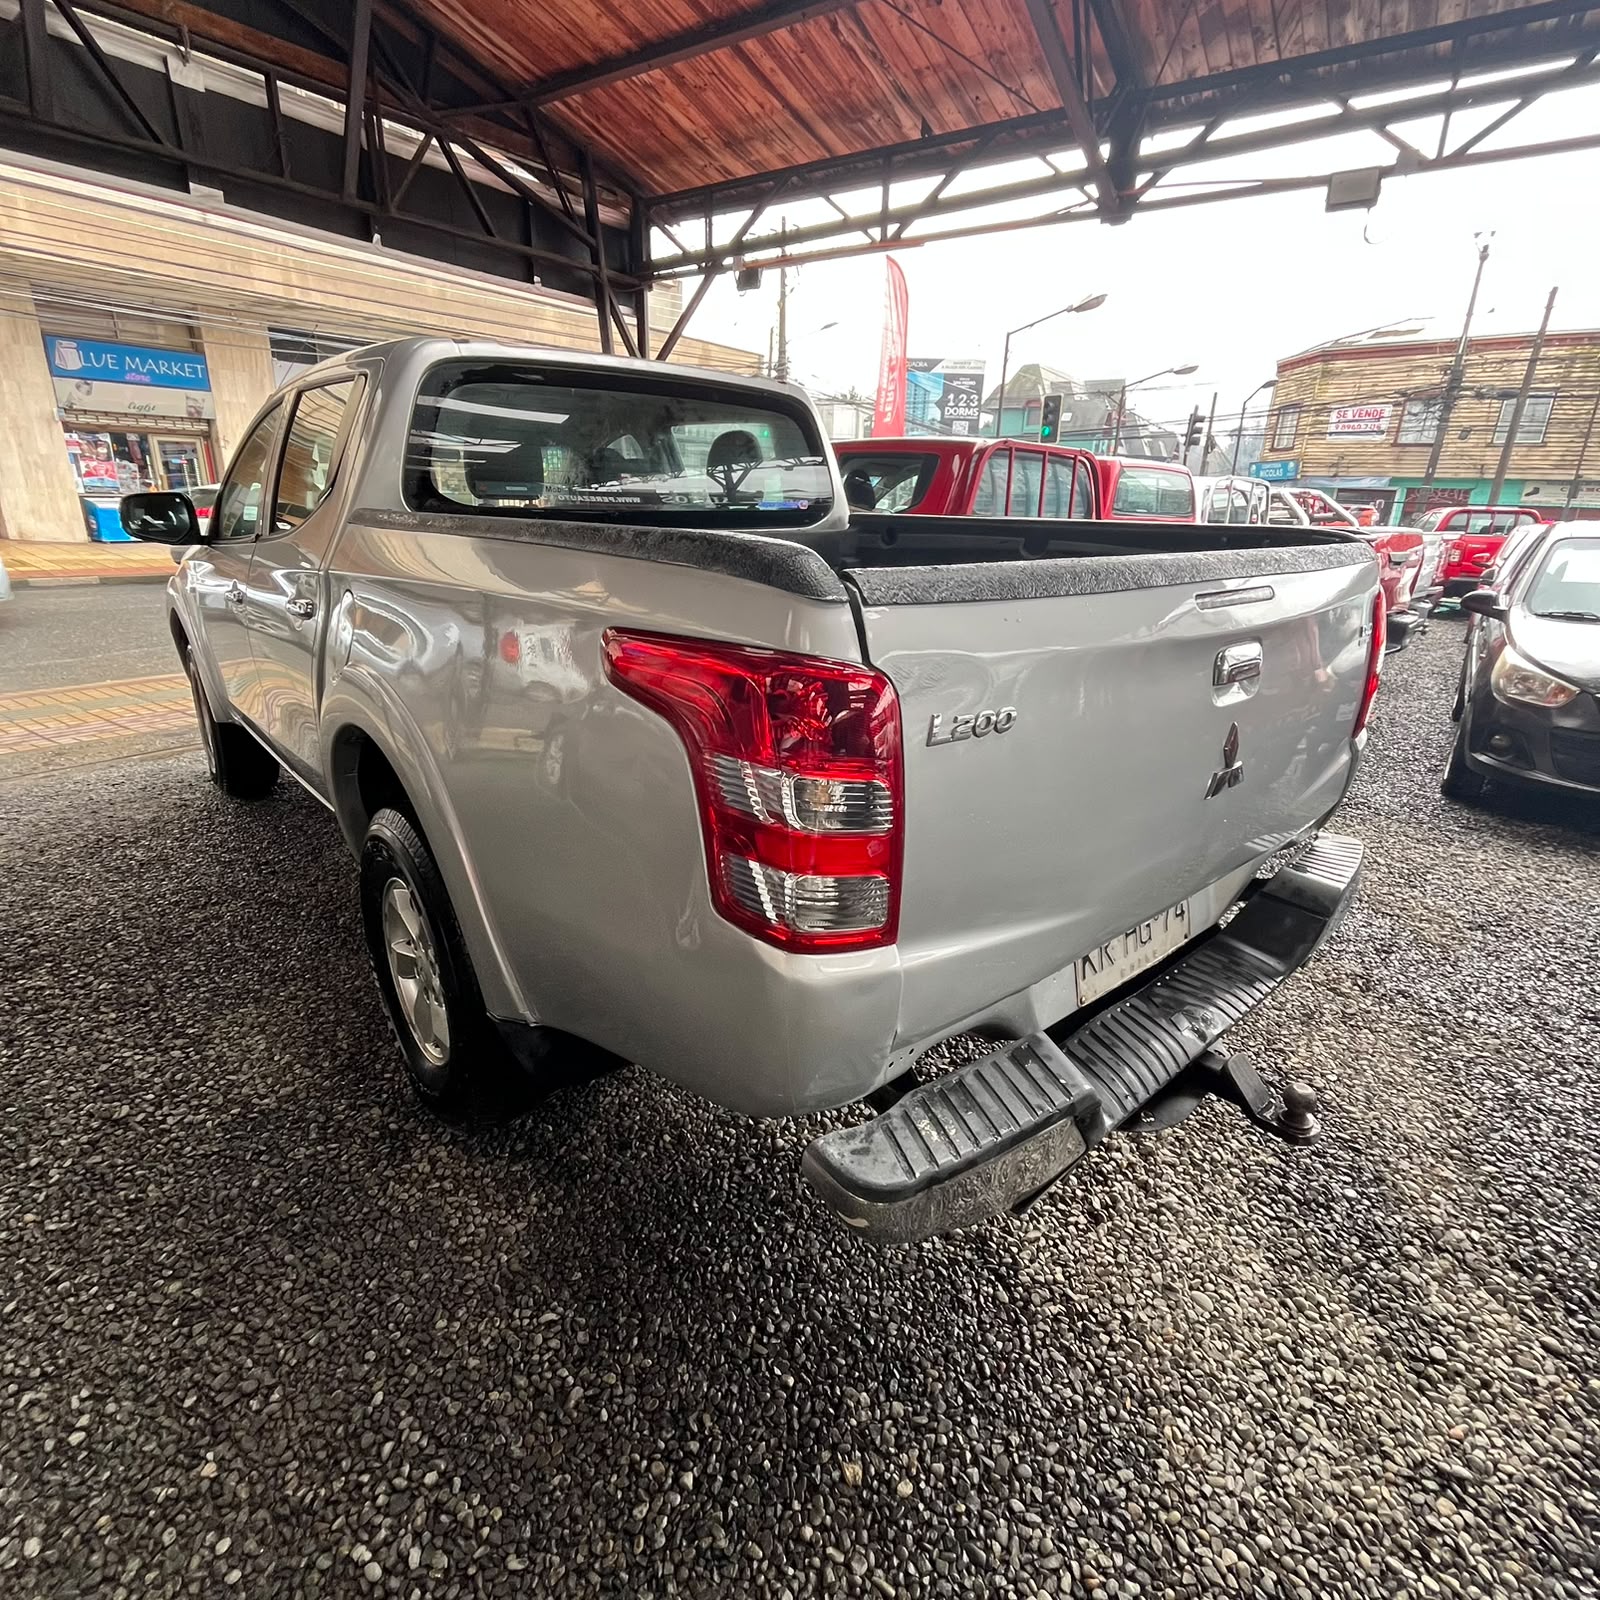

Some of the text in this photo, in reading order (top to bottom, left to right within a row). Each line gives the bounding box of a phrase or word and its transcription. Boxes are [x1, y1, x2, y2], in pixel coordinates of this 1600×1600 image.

[125, 355, 205, 379] MARKET
[944, 406, 979, 417] DORMS
[1336, 408, 1386, 419] SE VENDE
[925, 705, 1018, 747] L200
